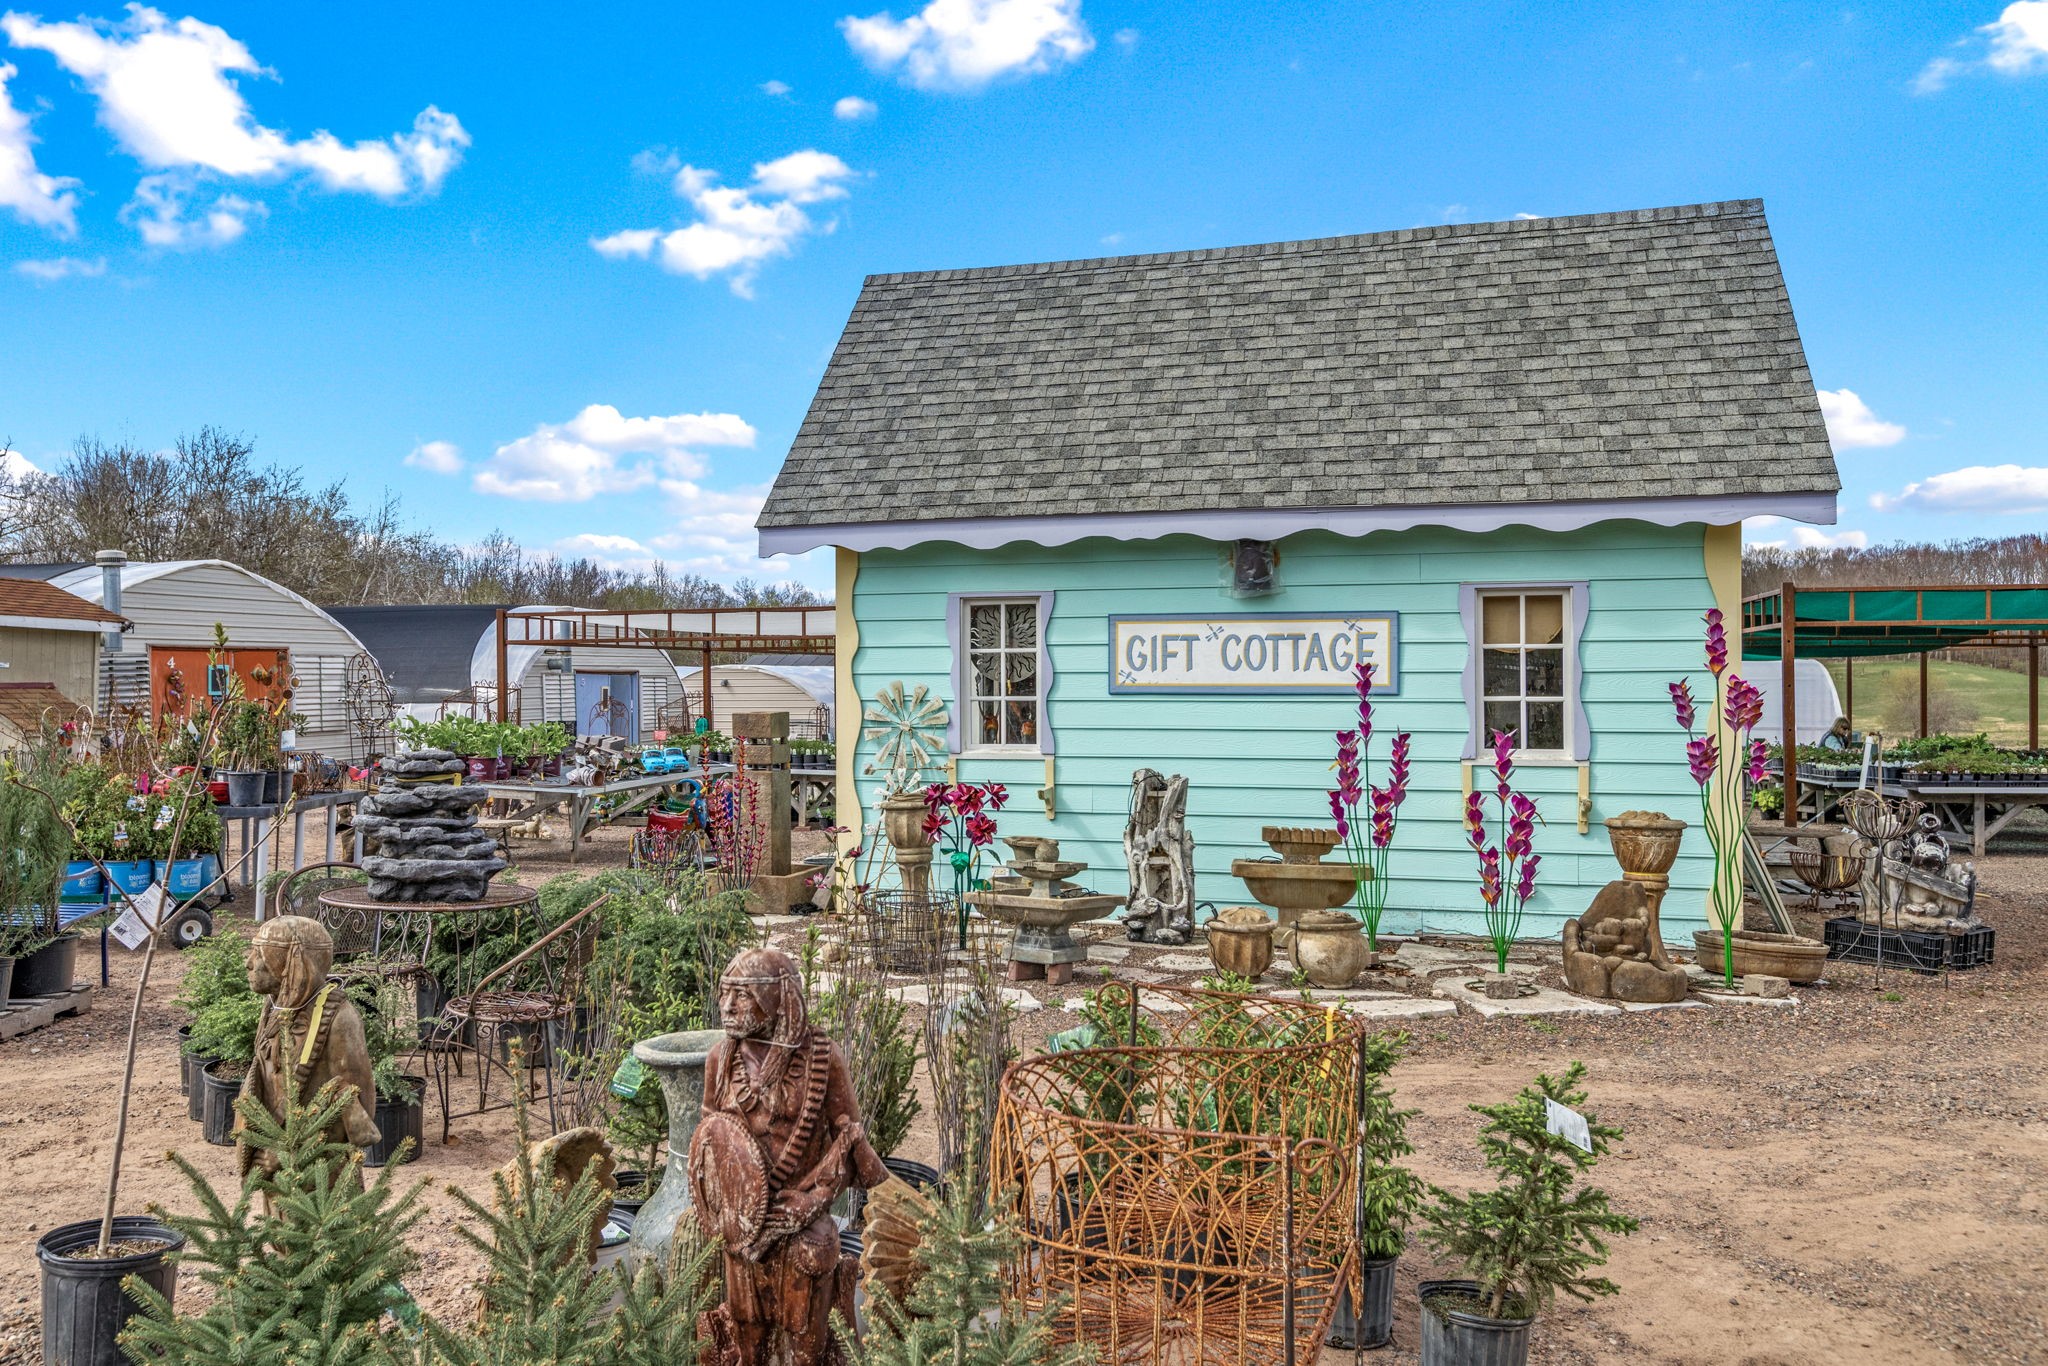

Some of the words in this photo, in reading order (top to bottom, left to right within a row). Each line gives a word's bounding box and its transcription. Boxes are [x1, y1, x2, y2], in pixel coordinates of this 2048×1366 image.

[167, 656, 176, 669] 4
[1126, 634, 1200, 673] GIFT
[1220, 632, 1379, 673] COTTAGE
